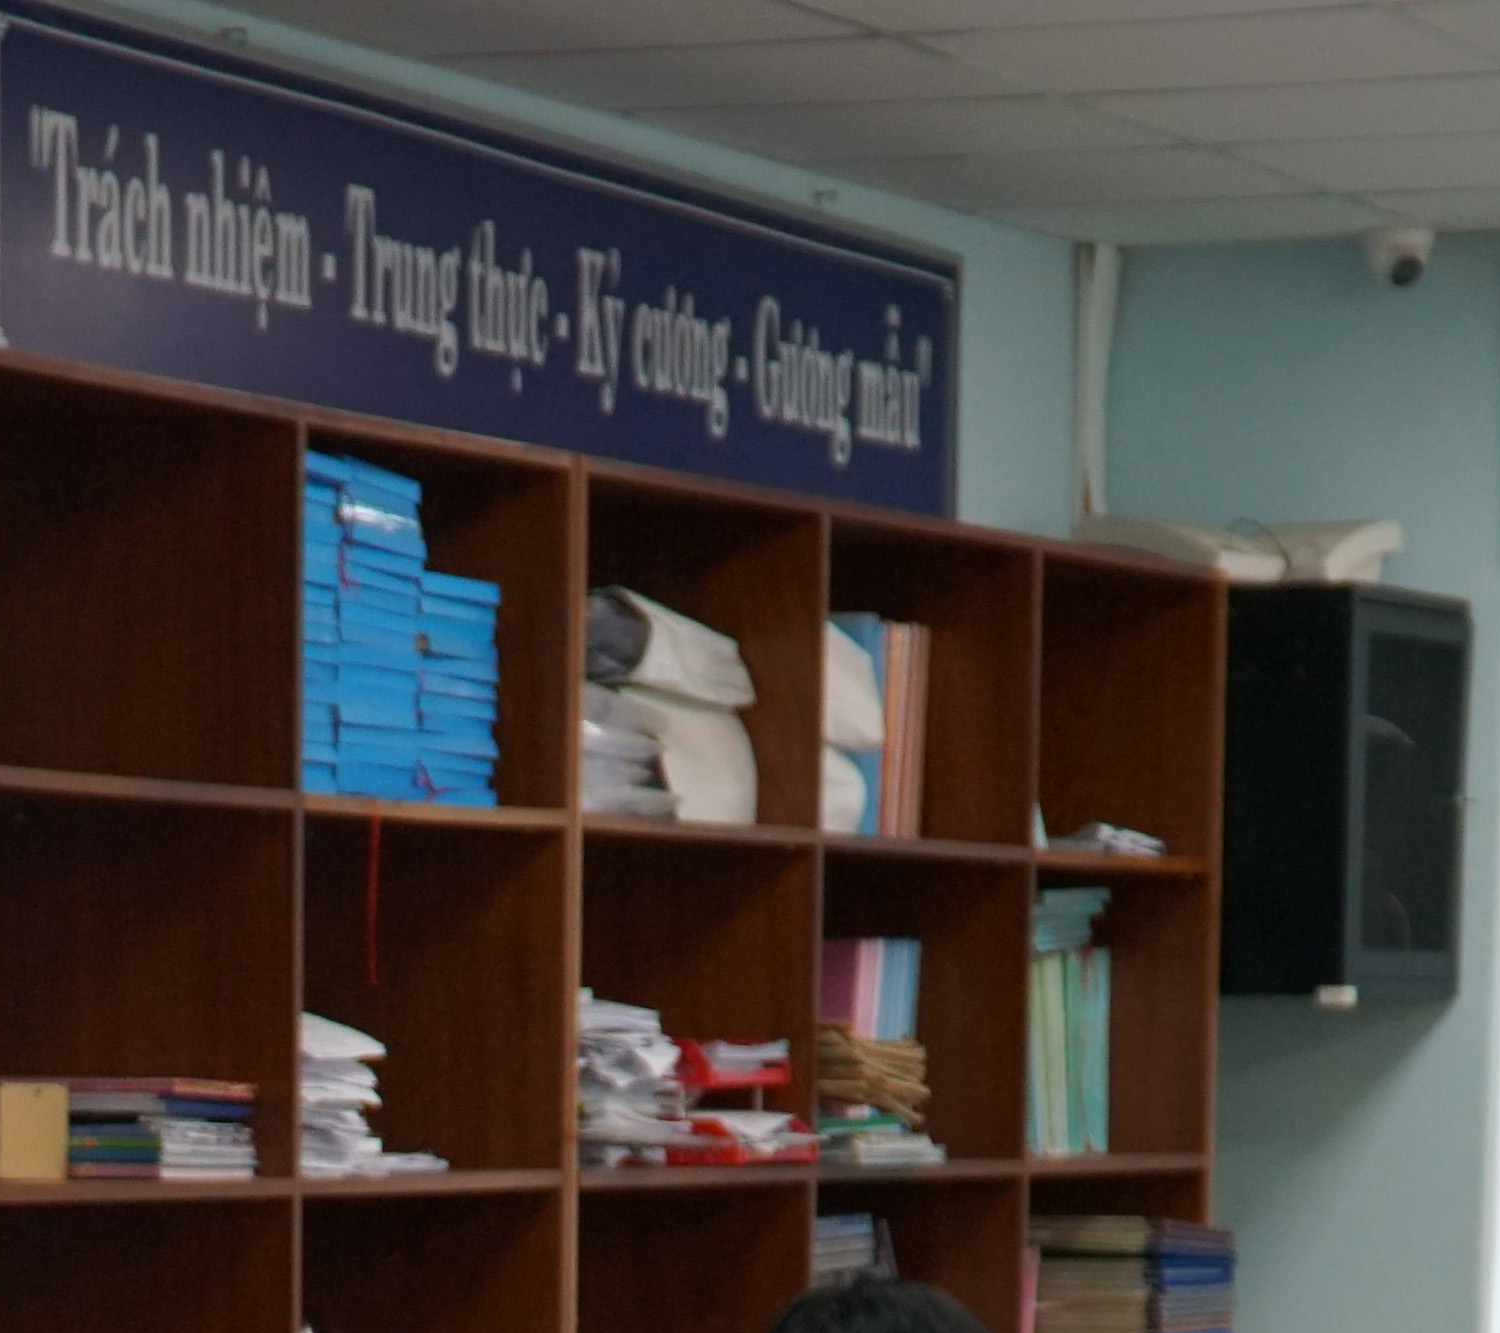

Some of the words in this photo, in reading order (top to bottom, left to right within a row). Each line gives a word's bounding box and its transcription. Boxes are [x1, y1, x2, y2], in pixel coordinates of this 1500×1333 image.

[29, 104, 175, 279] "Trách
[185, 148, 312, 333] nhiệm
[344, 182, 461, 378] Trung
[468, 219, 548, 394] thực
[632, 284, 731, 439] cương
[754, 295, 853, 470] Gương
